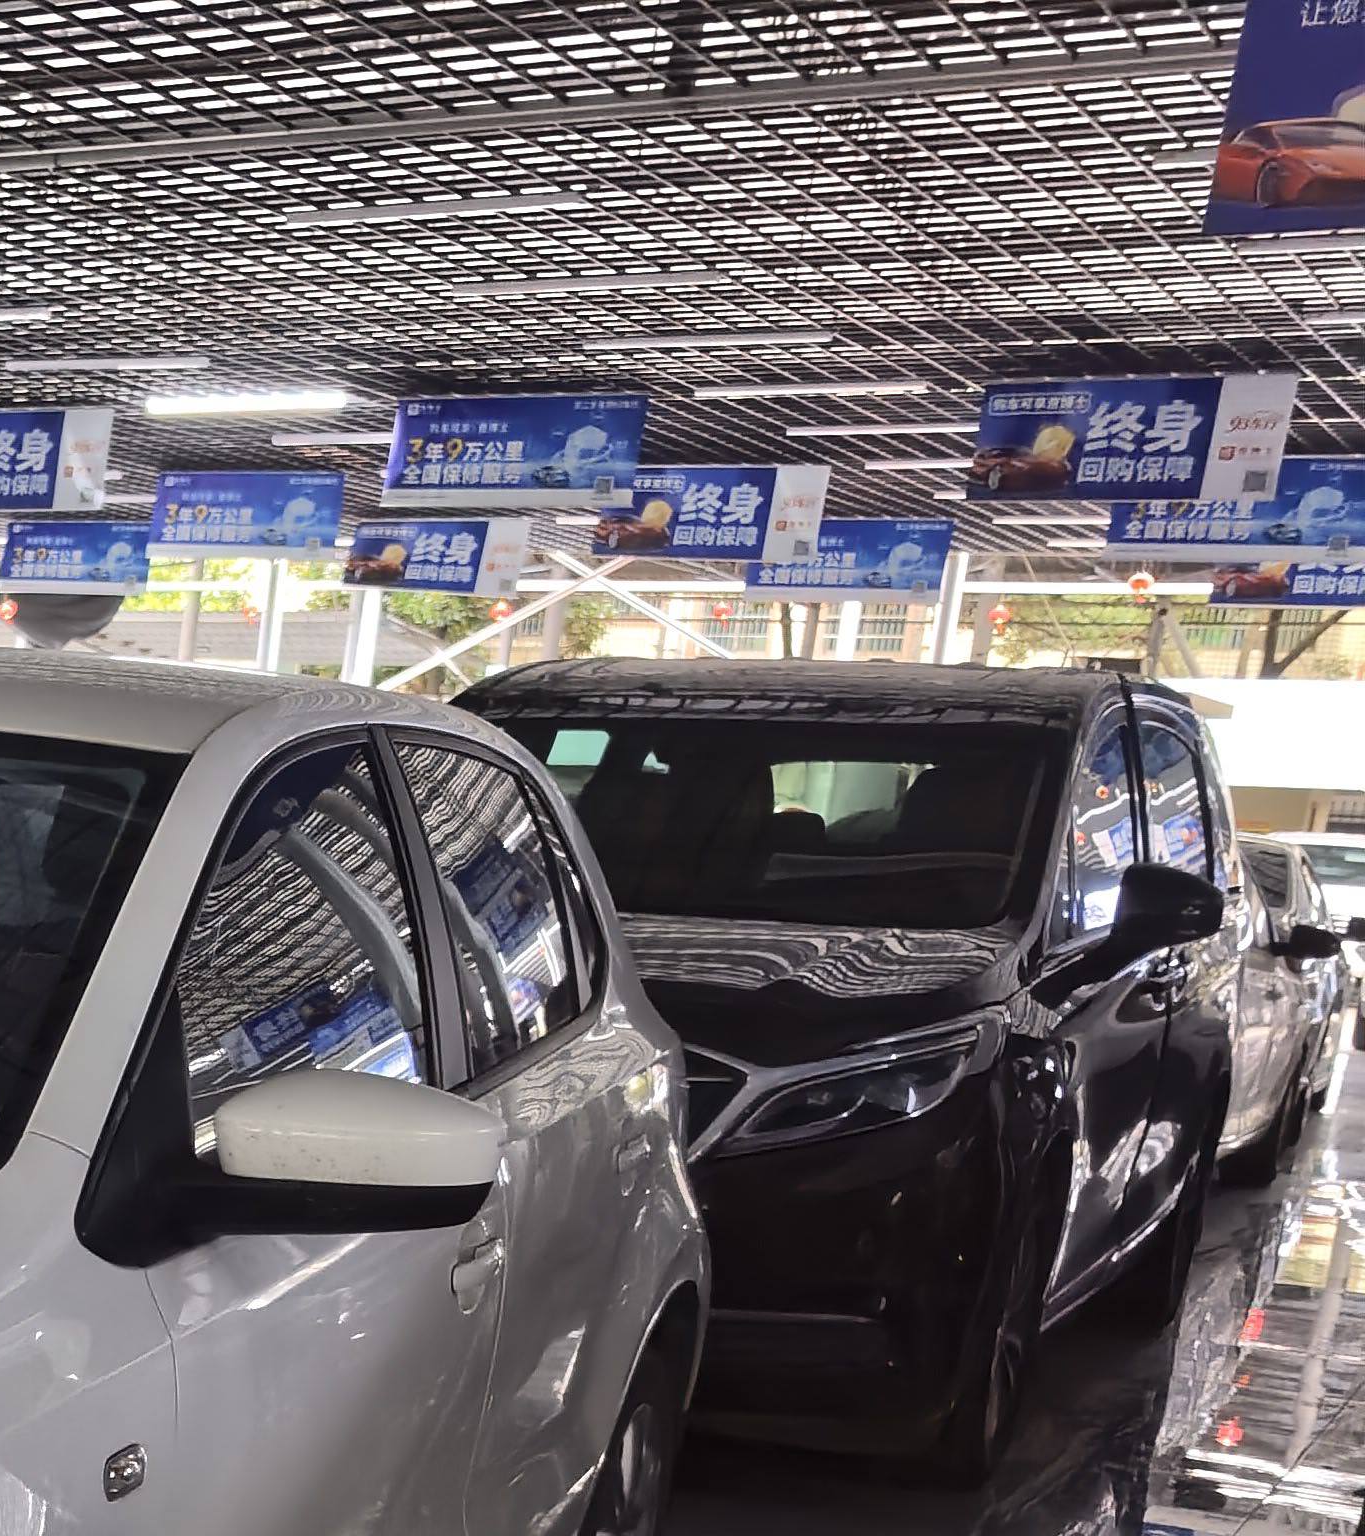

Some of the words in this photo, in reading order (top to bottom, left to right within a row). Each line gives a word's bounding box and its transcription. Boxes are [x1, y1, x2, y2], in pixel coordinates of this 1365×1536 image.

[1301, 0, 1365, 27] 让您
[1084, 400, 1204, 453] 终身
[407, 438, 526, 465] 3年9万公里
[1075, 456, 1195, 484] 回购保障
[678, 483, 765, 525] 终身
[672, 525, 759, 548] 回购保障
